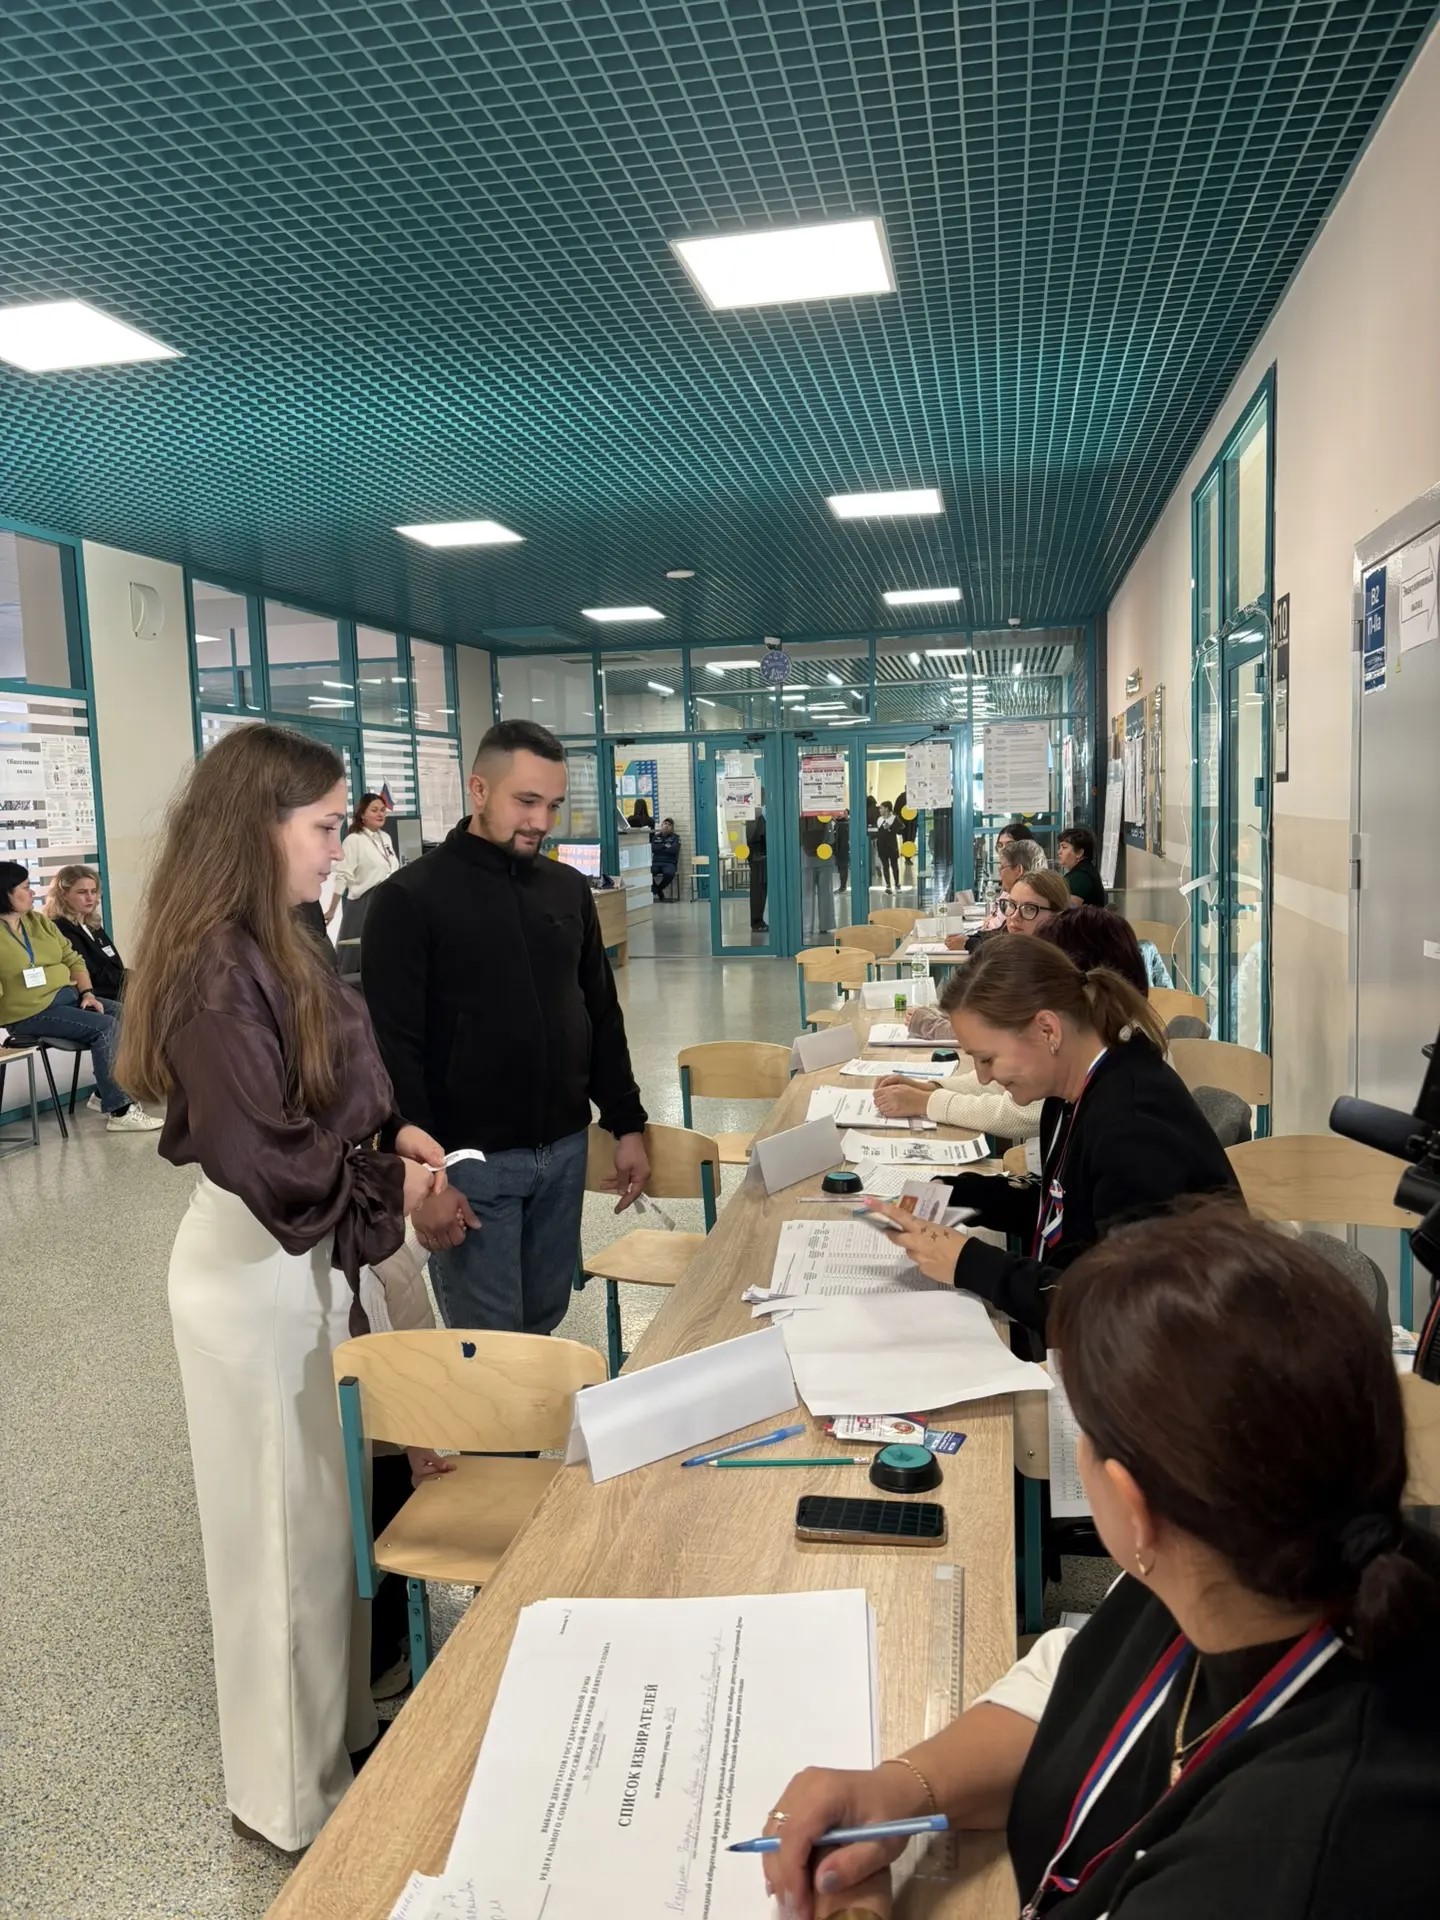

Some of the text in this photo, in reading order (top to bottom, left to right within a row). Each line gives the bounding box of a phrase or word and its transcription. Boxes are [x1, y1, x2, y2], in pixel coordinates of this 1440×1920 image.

[540, 1822, 562, 1880] ФЕДЕРАЛЬНОГО
[557, 1783, 573, 1820] СОБРАНИЯ
[568, 1736, 585, 1781] РОССИЙСКОЙ
[581, 1696, 596, 1734] ФЕДЕРАЦИИ
[541, 1802, 555, 1833] ВЫБОРЫ
[551, 1760, 568, 1800] ДЕПУТАТОВ
[563, 1695, 585, 1758] ГОСУДАРСТВЕННОЙ
[619, 1685, 657, 1827] СПИСОК ИЗБИРАТЕЛЕЙ
